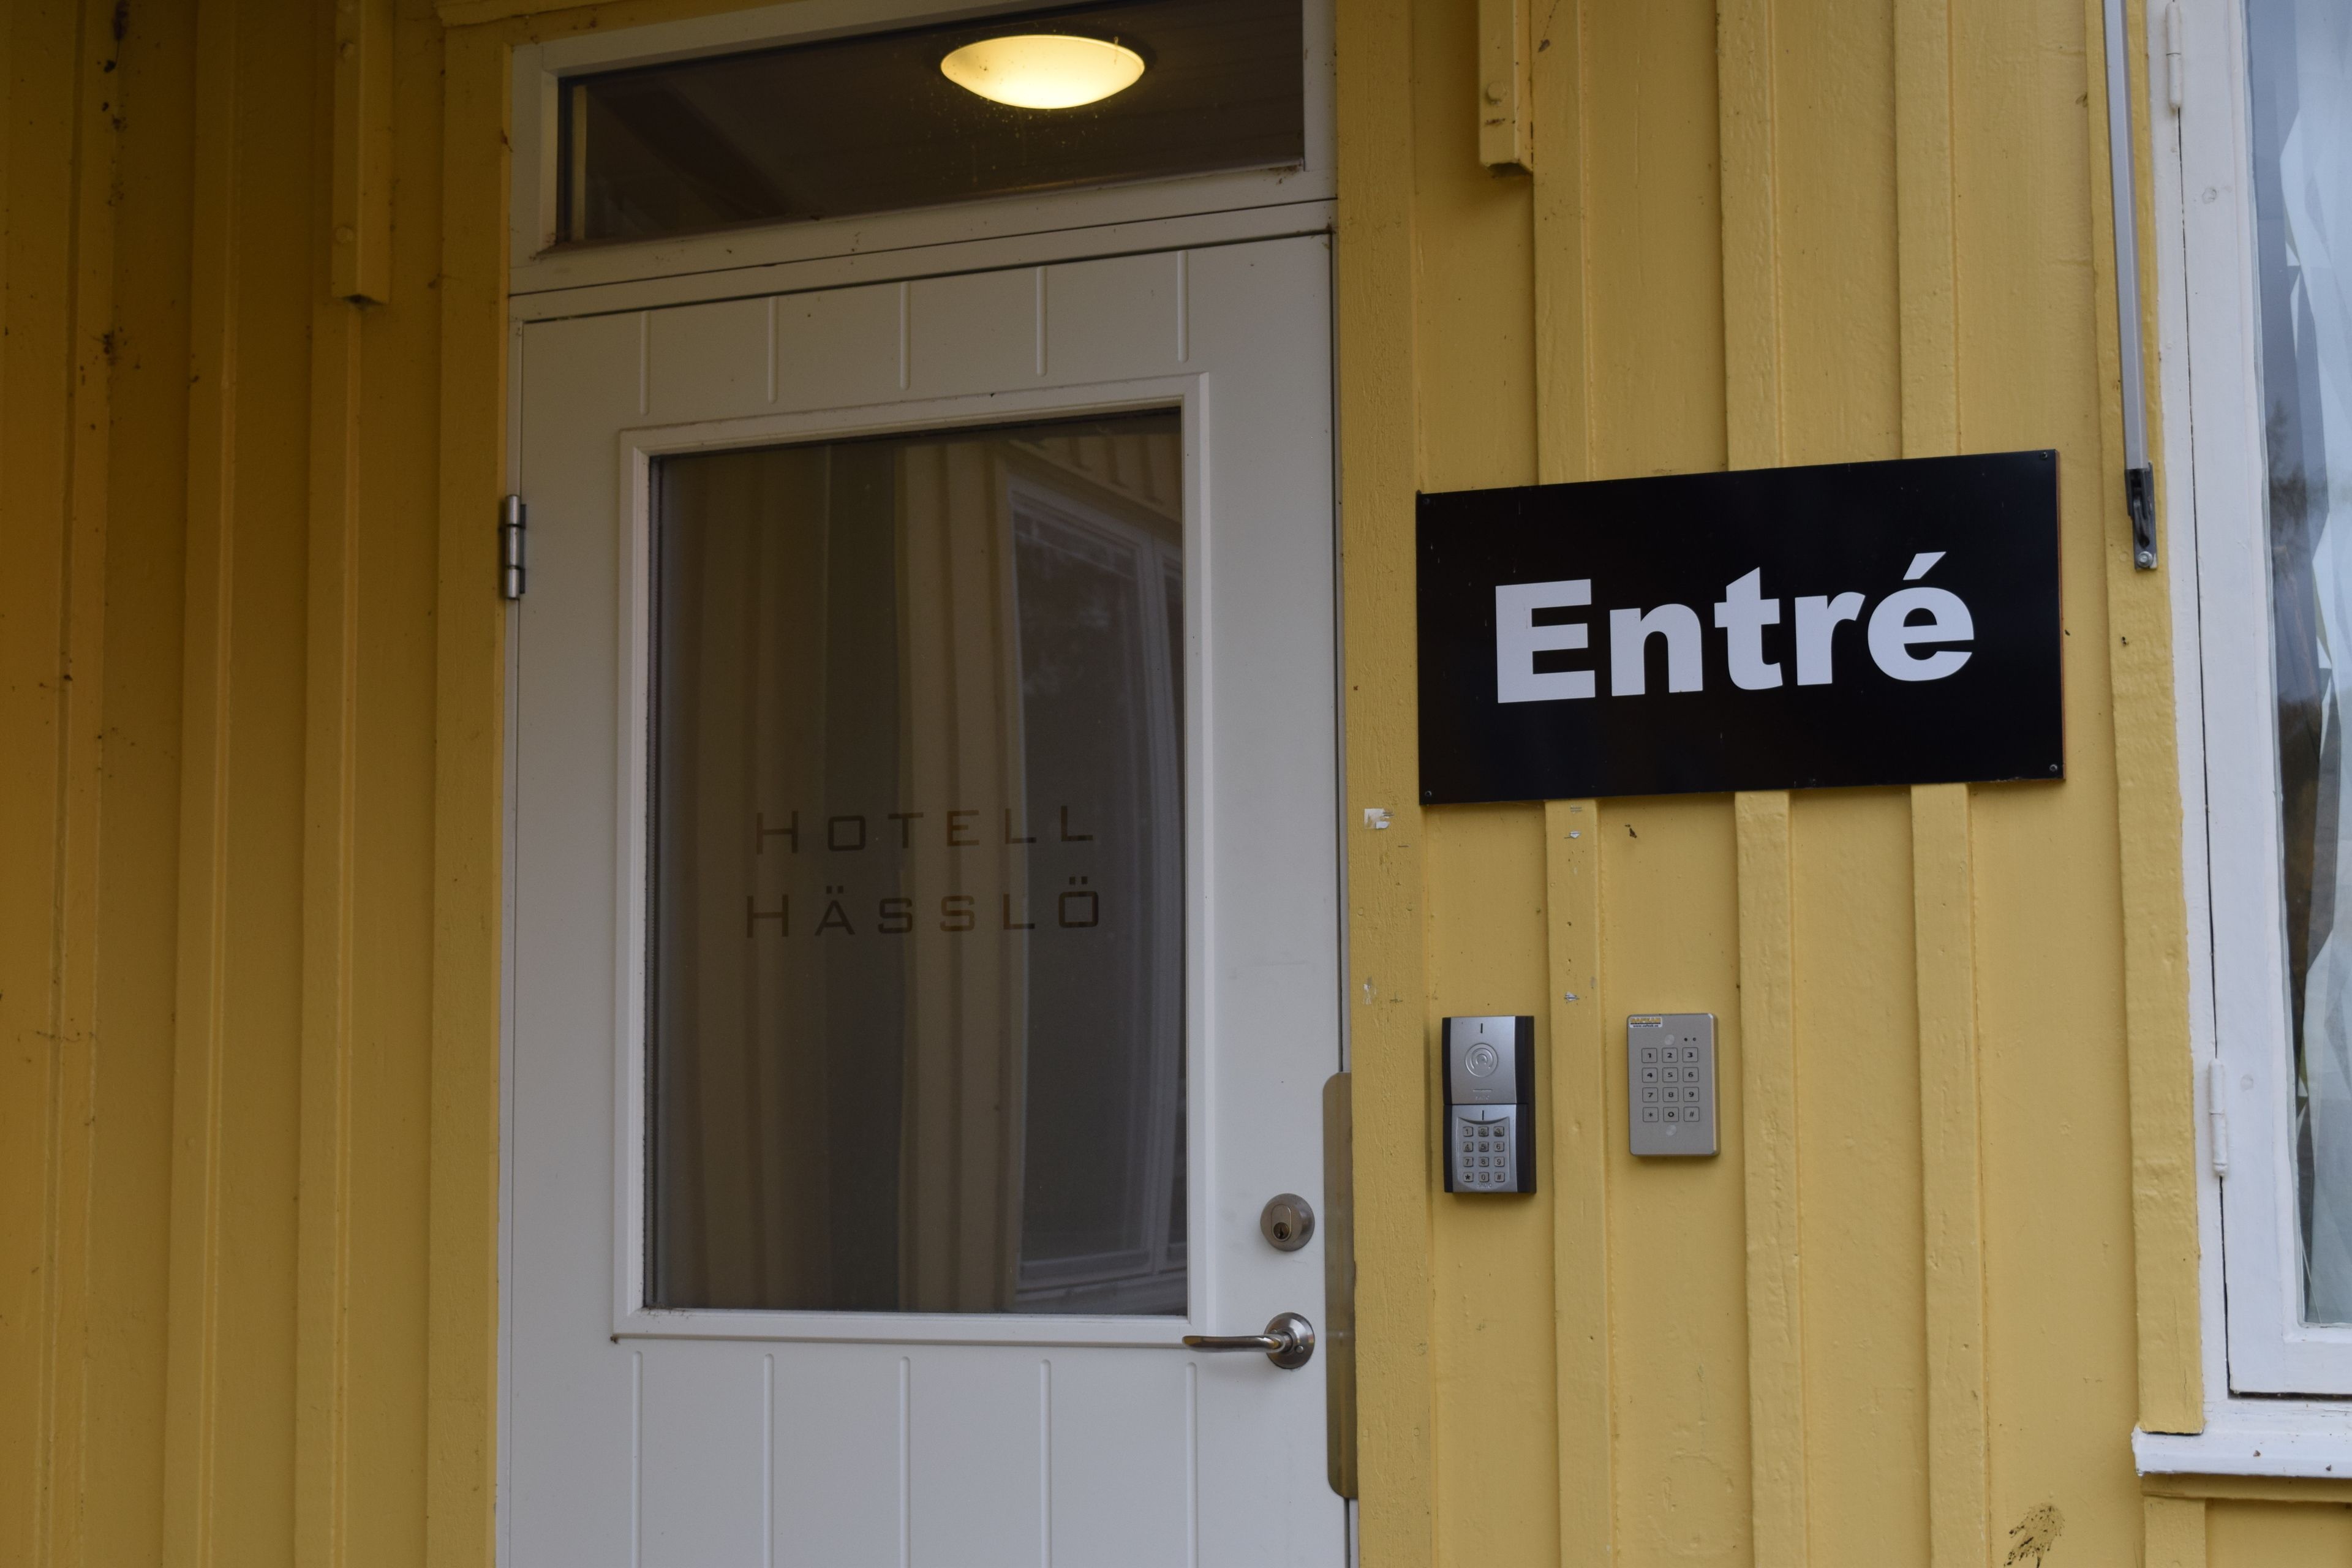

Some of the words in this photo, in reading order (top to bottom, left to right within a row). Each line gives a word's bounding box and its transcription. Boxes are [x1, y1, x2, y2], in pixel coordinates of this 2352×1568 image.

[1495, 551, 1974, 704] Entré
[756, 805, 1094, 855] HOTELL
[747, 875, 1100, 938] HÄSSLÖ
